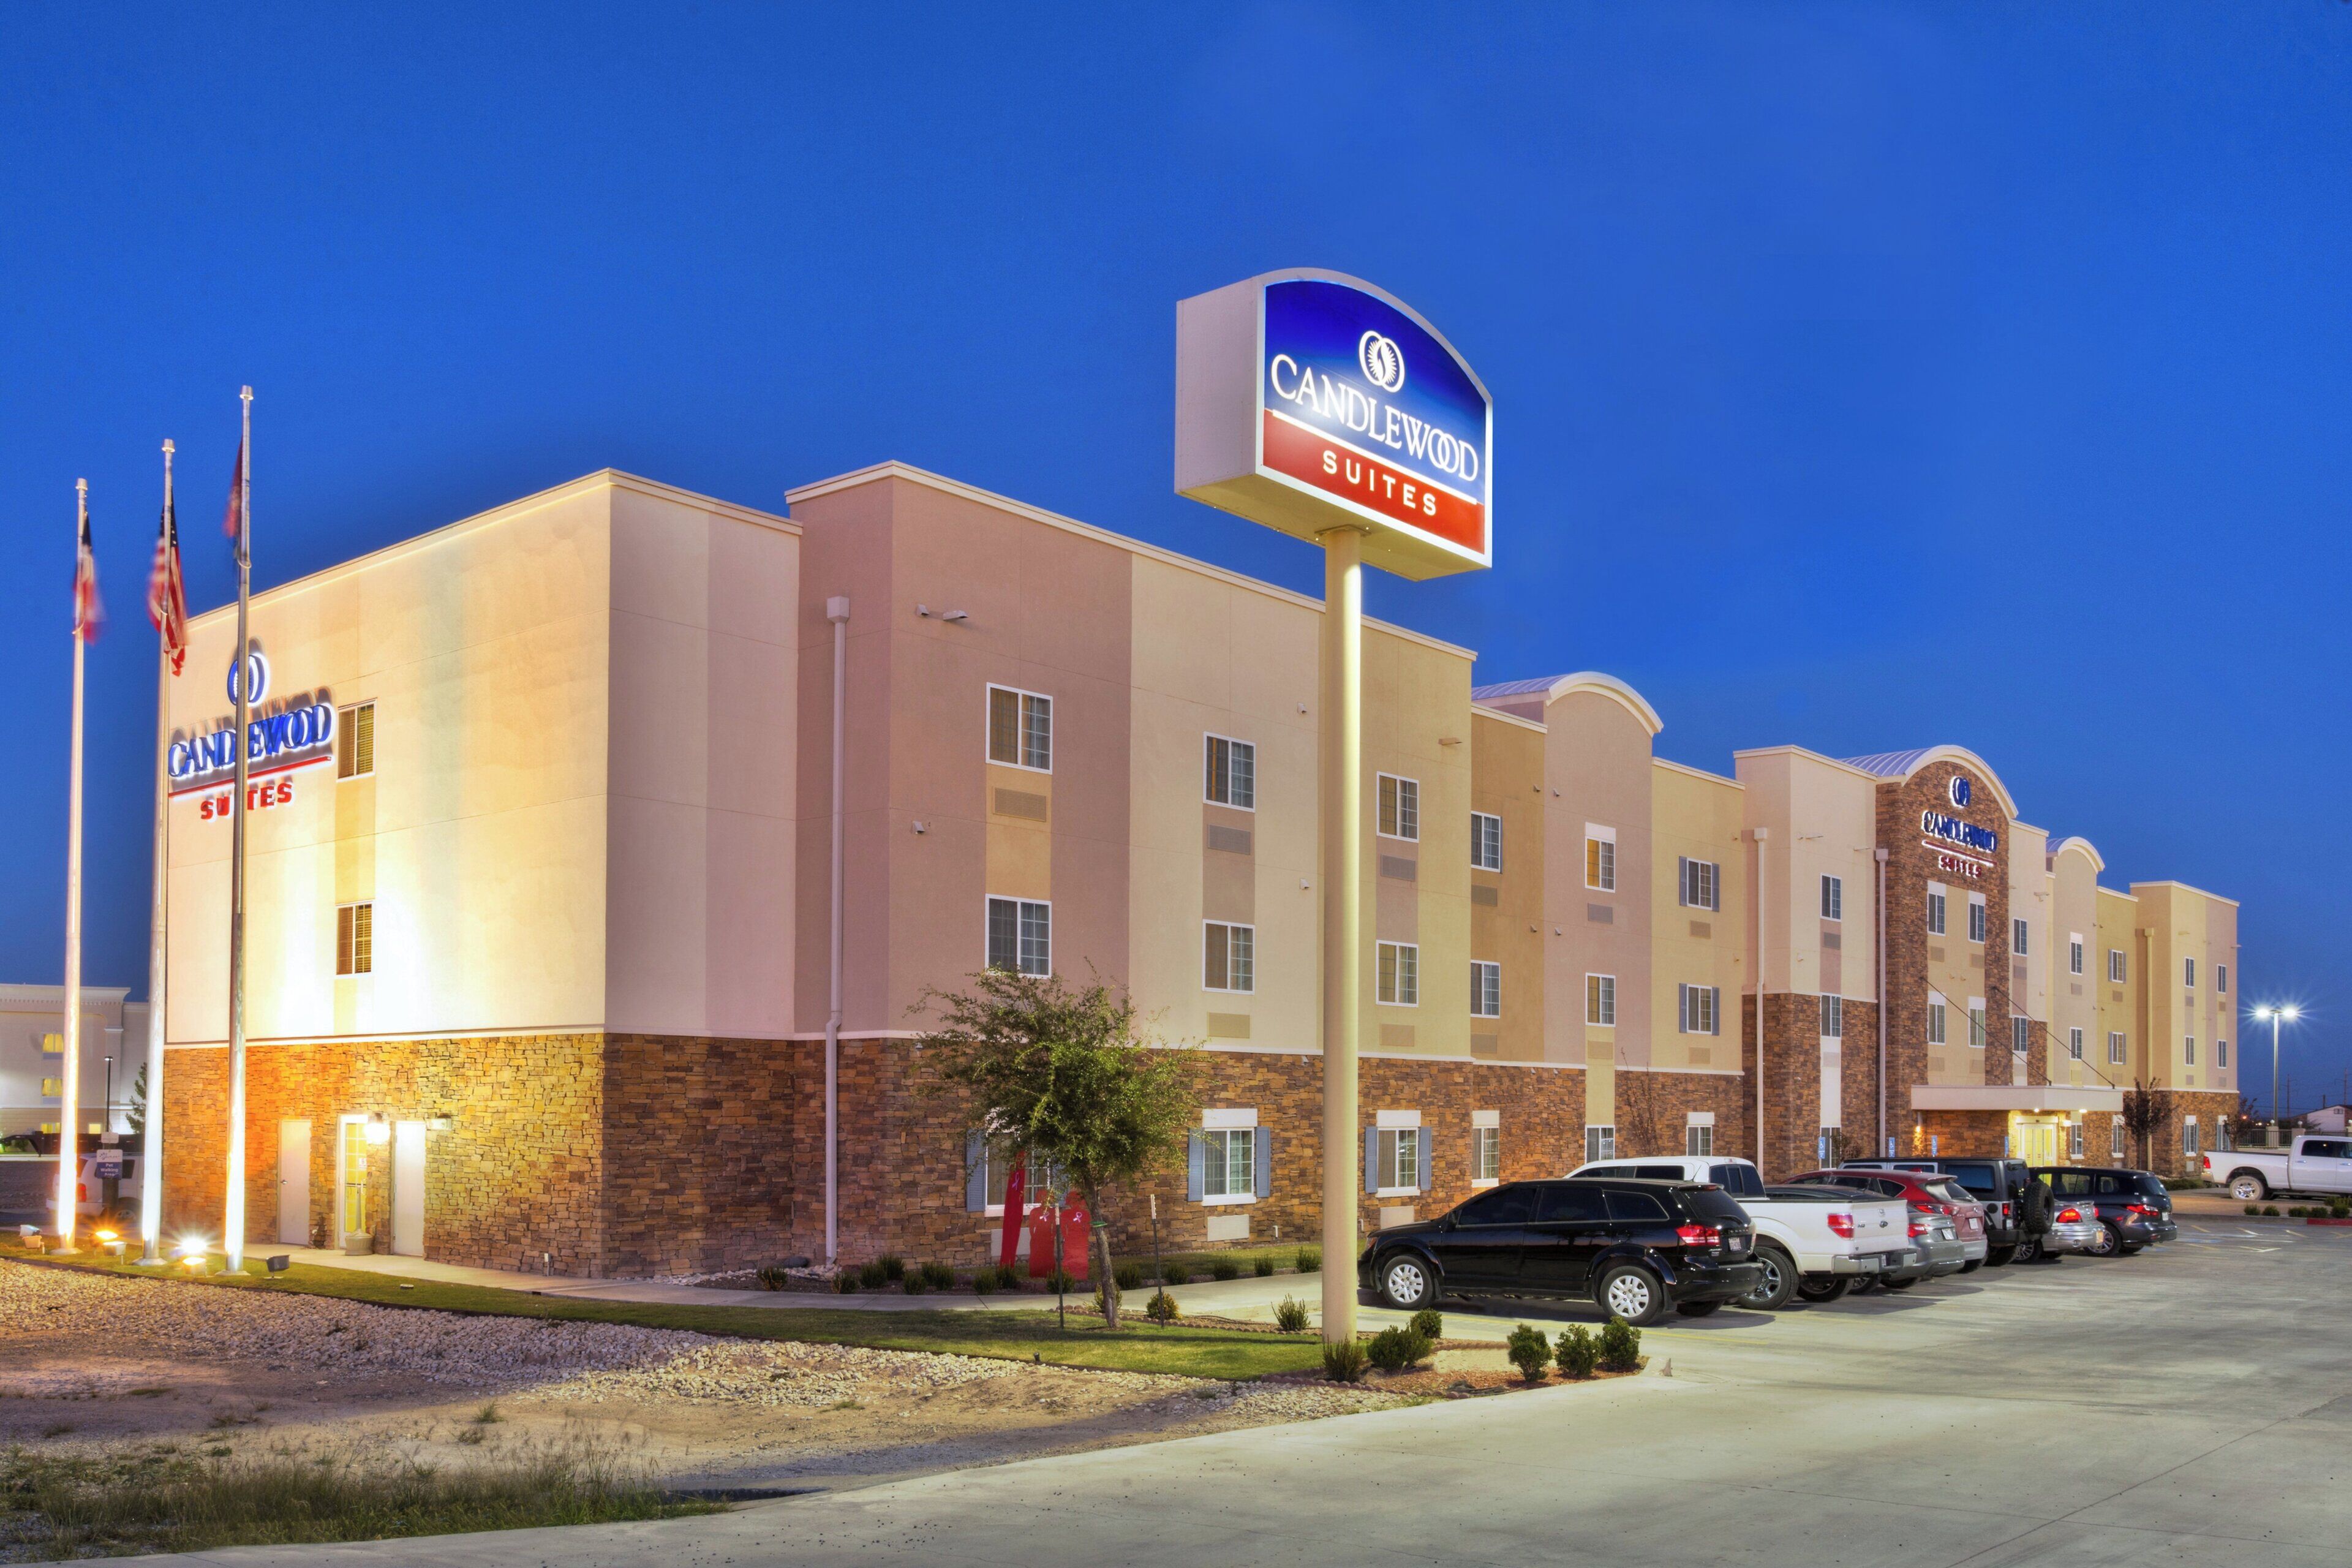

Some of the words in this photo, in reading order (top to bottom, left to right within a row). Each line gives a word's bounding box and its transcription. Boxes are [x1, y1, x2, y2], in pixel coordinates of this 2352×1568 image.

[1270, 353, 1479, 482] CANDLEWOOD
[1322, 450, 1437, 516] SUITES
[168, 704, 333, 777] CANDEWOOD
[200, 782, 292, 820] SUTES
